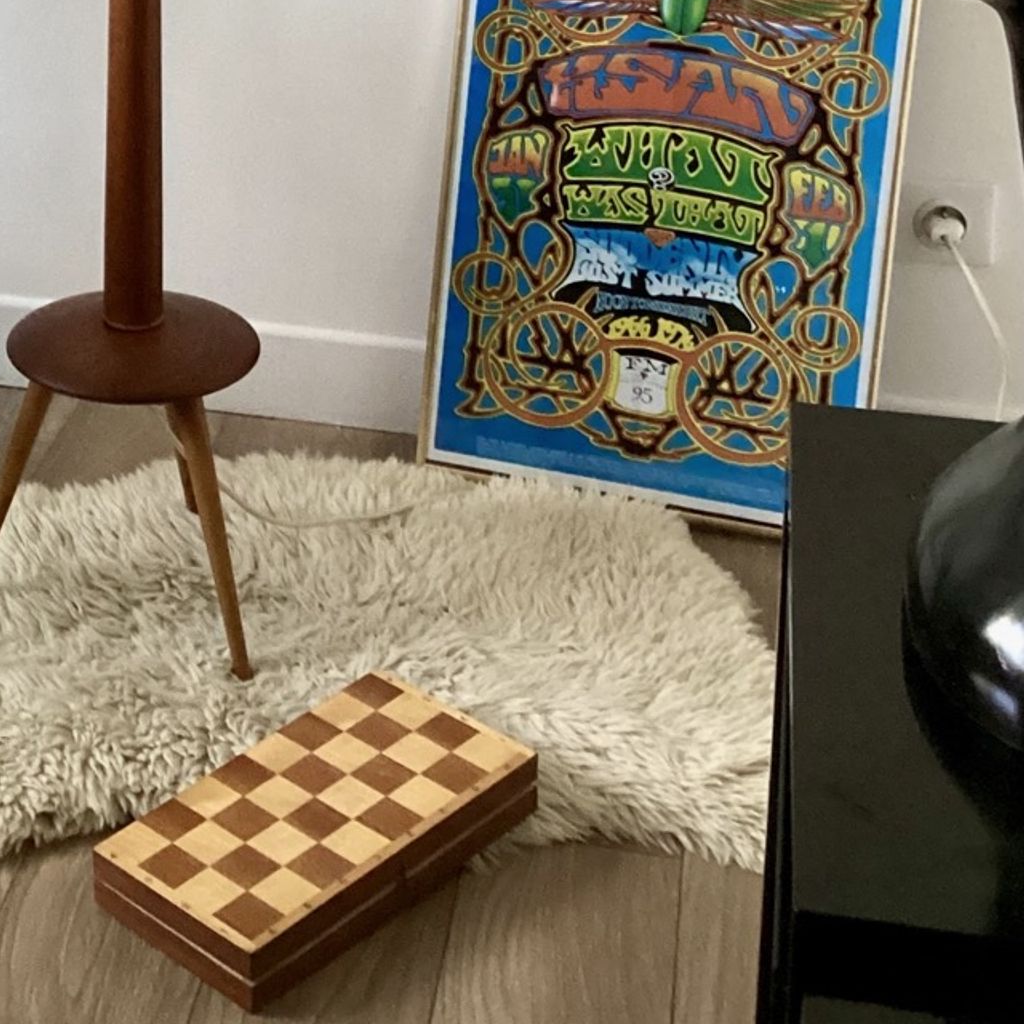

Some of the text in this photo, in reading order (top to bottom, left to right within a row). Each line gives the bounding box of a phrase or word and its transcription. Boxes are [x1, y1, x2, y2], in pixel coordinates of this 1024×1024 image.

[488, 132, 545, 175] JAN
[562, 184, 766, 246] WAS THAT
[790, 169, 848, 223] FEB
[645, 265, 742, 304] SUMMER
[624, 355, 669, 376] FM
[631, 386, 654, 405] 95
